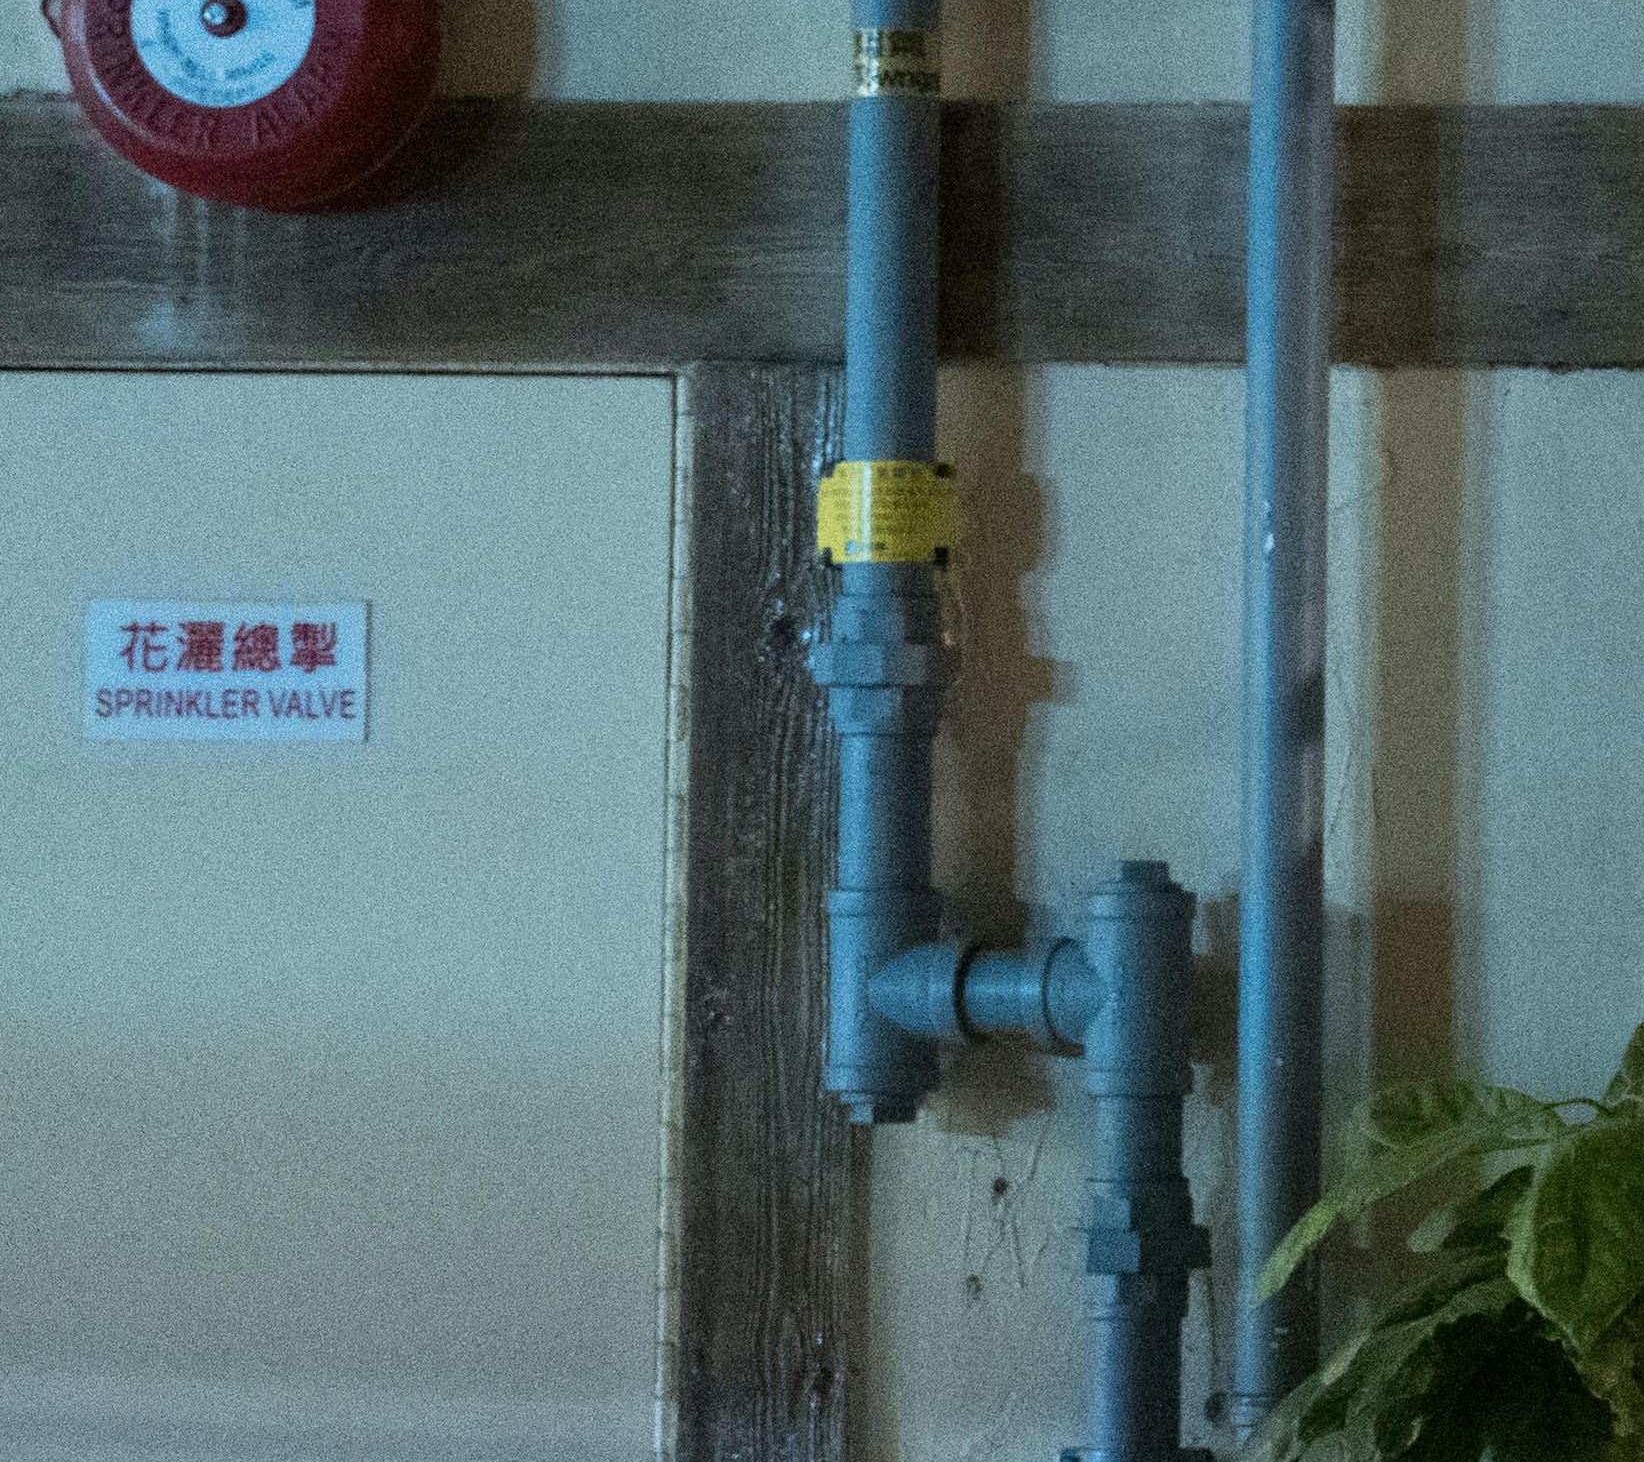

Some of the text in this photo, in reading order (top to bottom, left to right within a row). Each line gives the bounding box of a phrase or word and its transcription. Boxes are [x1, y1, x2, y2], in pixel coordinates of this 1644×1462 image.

[119, 620, 338, 674] 花灑總掣
[95, 688, 357, 720] SPRINKLER VALVE
